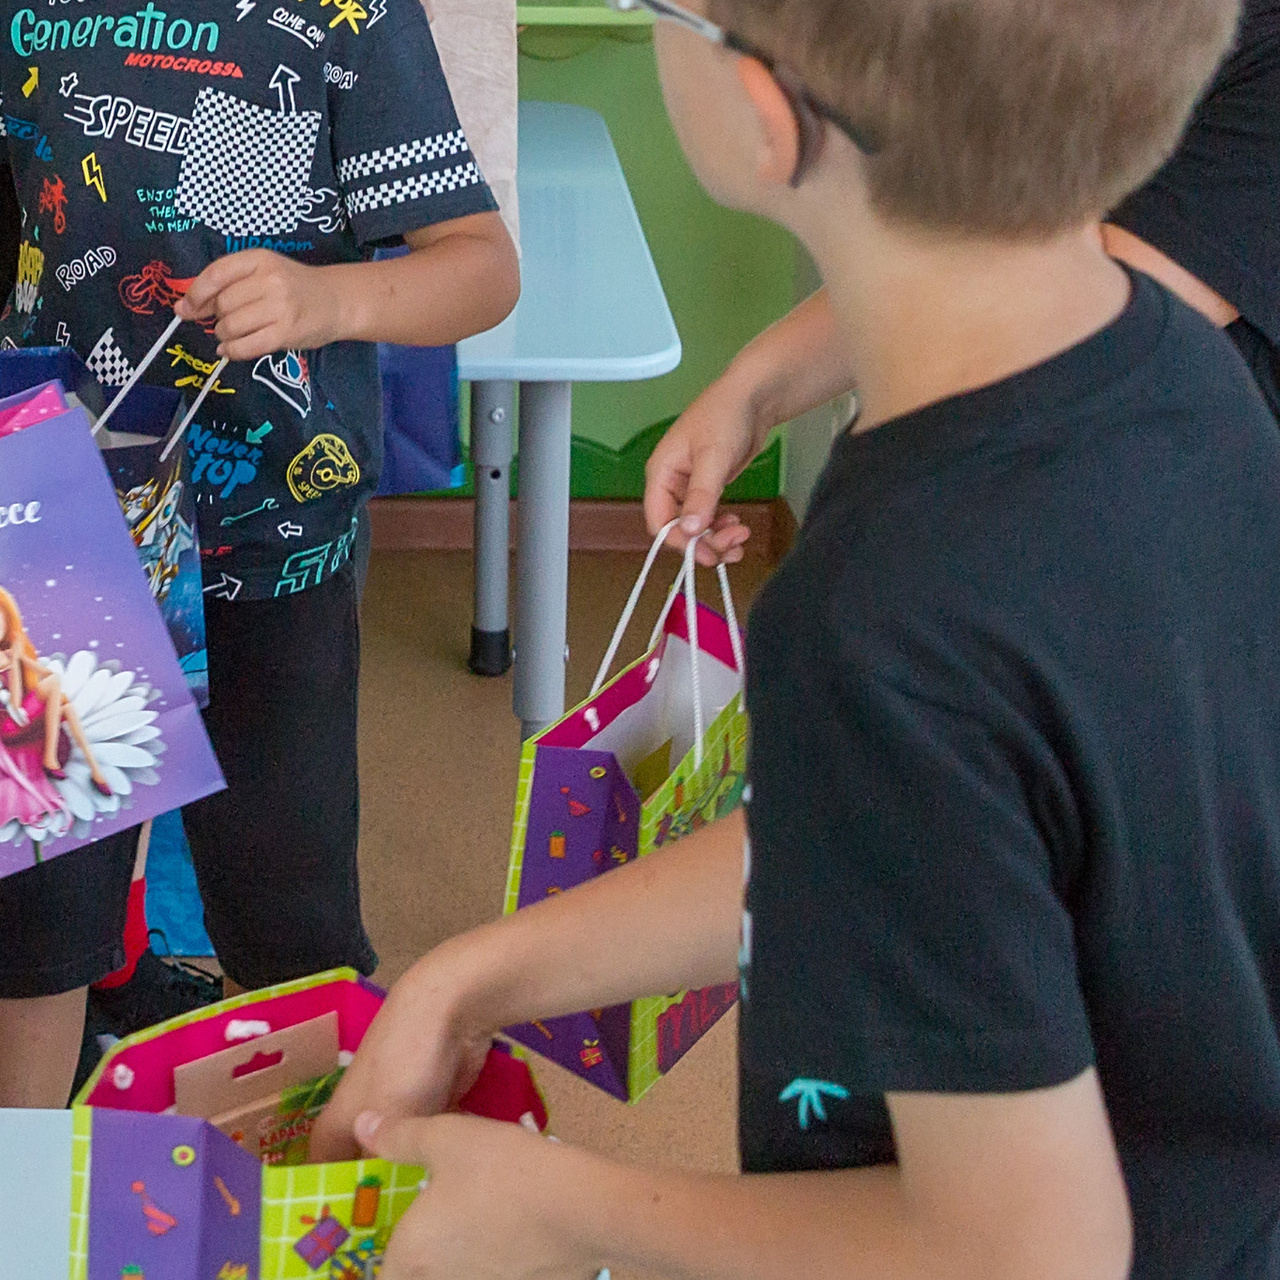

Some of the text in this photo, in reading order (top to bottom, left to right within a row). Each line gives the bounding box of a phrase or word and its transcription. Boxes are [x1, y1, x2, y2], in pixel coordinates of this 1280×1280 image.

[10, 1, 219, 57] Generation
[273, 7, 306, 32] COME
[124, 53, 236, 77] MOTOCROSS
[84, 92, 192, 156] SPEED
[55, 246, 117, 291] ROAD
